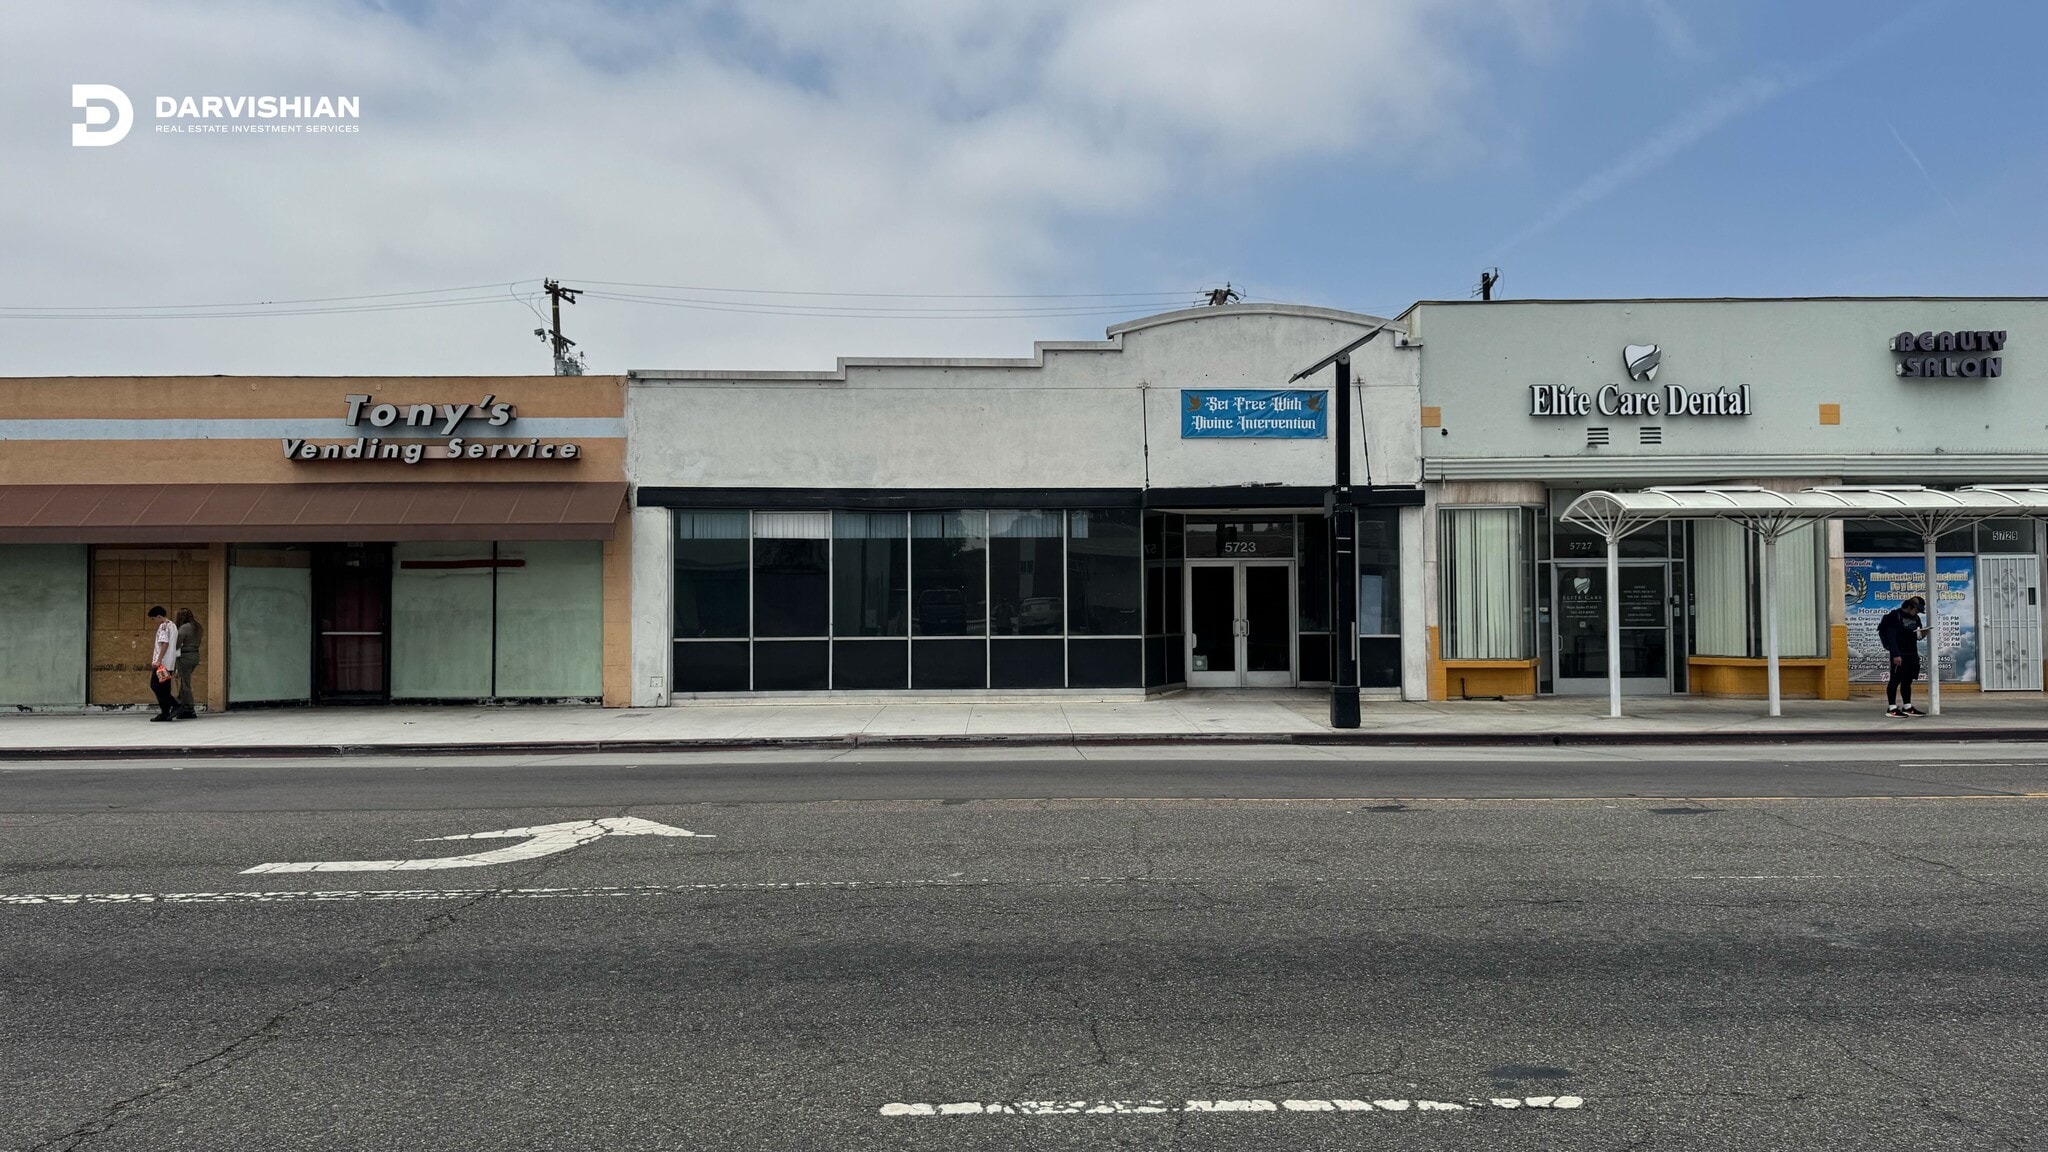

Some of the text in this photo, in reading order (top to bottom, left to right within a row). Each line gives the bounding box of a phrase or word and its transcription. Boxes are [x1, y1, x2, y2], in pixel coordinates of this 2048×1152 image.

[1897, 331, 2007, 351] BEAUTY
[1904, 357, 2003, 378] SALON
[1205, 396, 1302, 413] Set Free With
[1530, 384, 1752, 415] Elite Care Dental
[345, 394, 514, 435] Tony's
[1191, 415, 1317, 432] Divine Intervention
[282, 438, 579, 464] Vending Service
[1992, 531, 2018, 541] 5729
[1224, 542, 1256, 553] 5723
[1569, 542, 1592, 550] 5727
[1858, 607, 1889, 615] Horario
